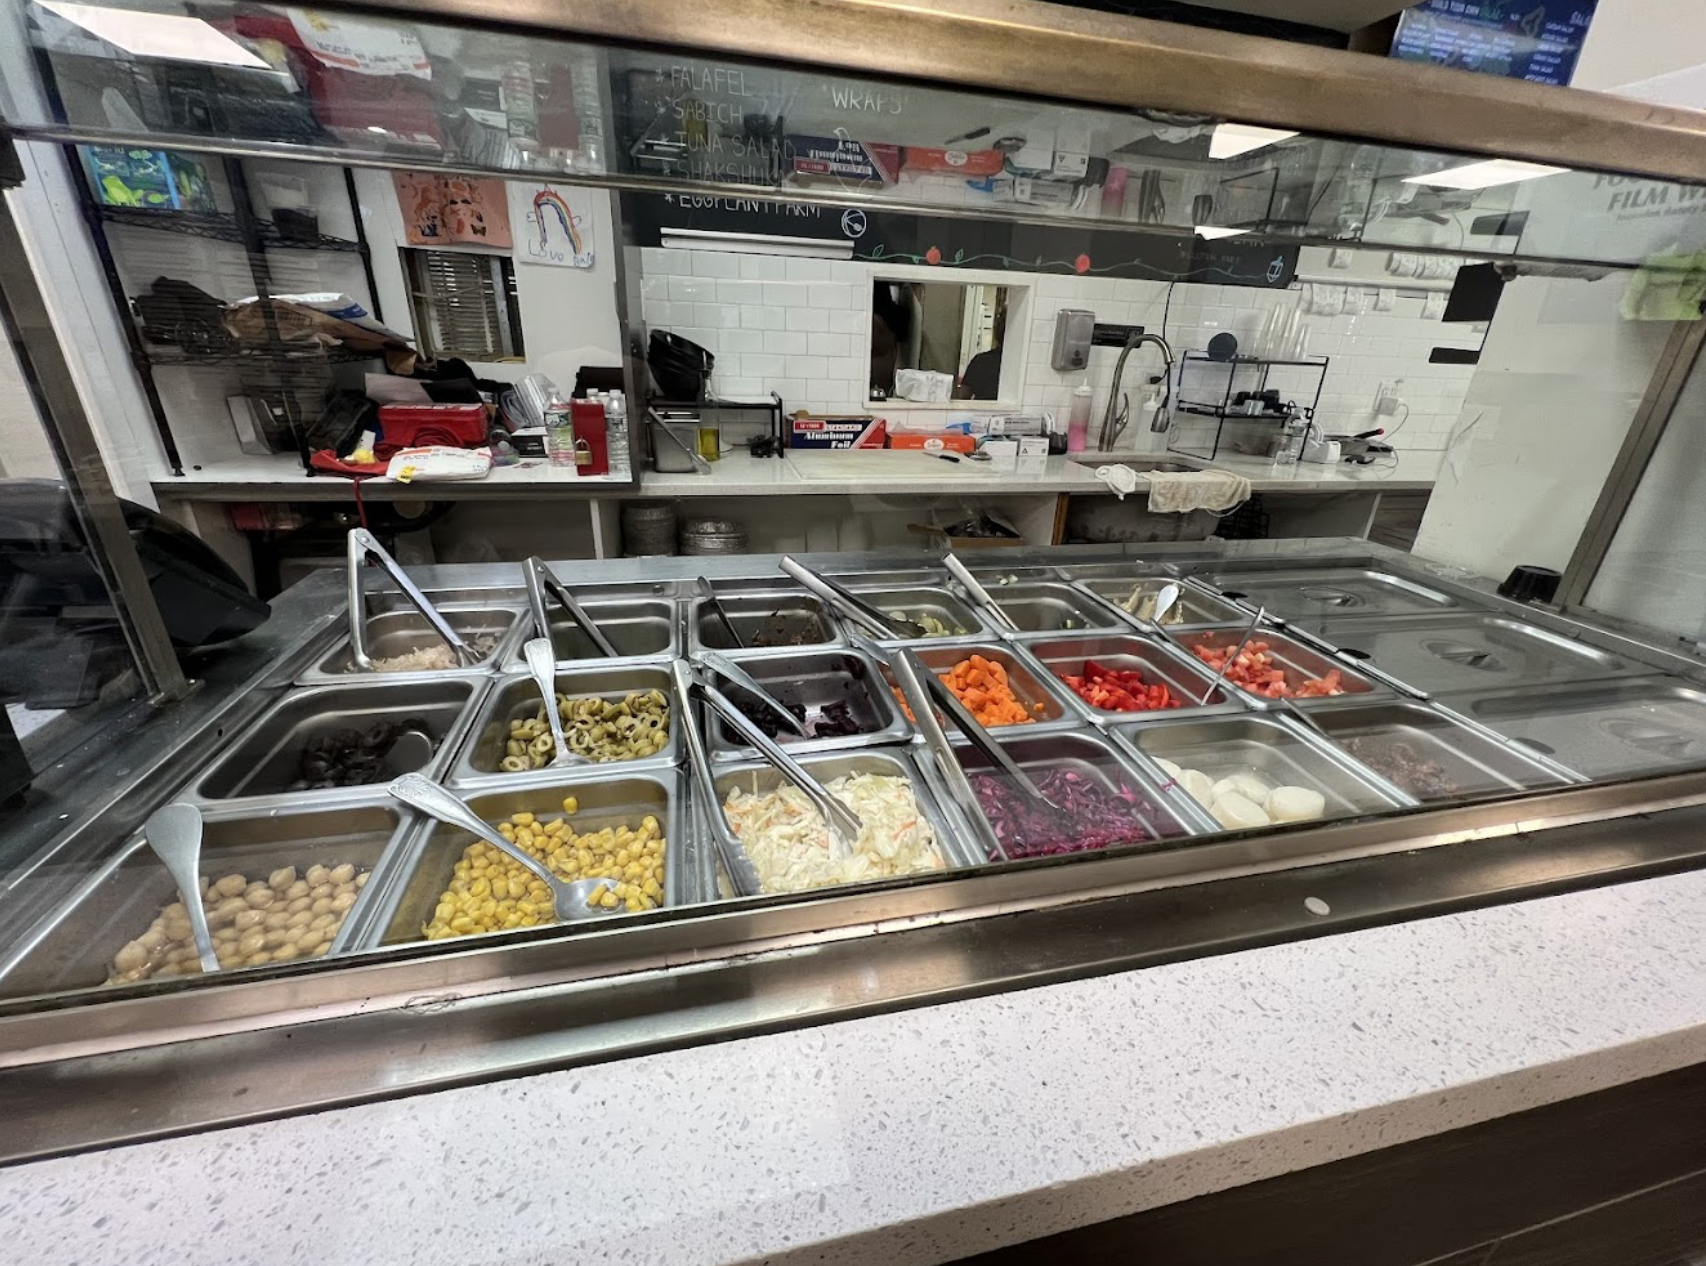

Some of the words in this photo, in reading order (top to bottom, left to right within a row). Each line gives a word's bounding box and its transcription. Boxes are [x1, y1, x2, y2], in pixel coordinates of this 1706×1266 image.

[671, 65, 753, 97] FALAFEL
[672, 99, 742, 124] SABICH
[674, 131, 723, 155] TUNA
[731, 134, 797, 160] SALAD
[1606, 186, 1670, 212] FILM
[831, 440, 852, 449] Foil
